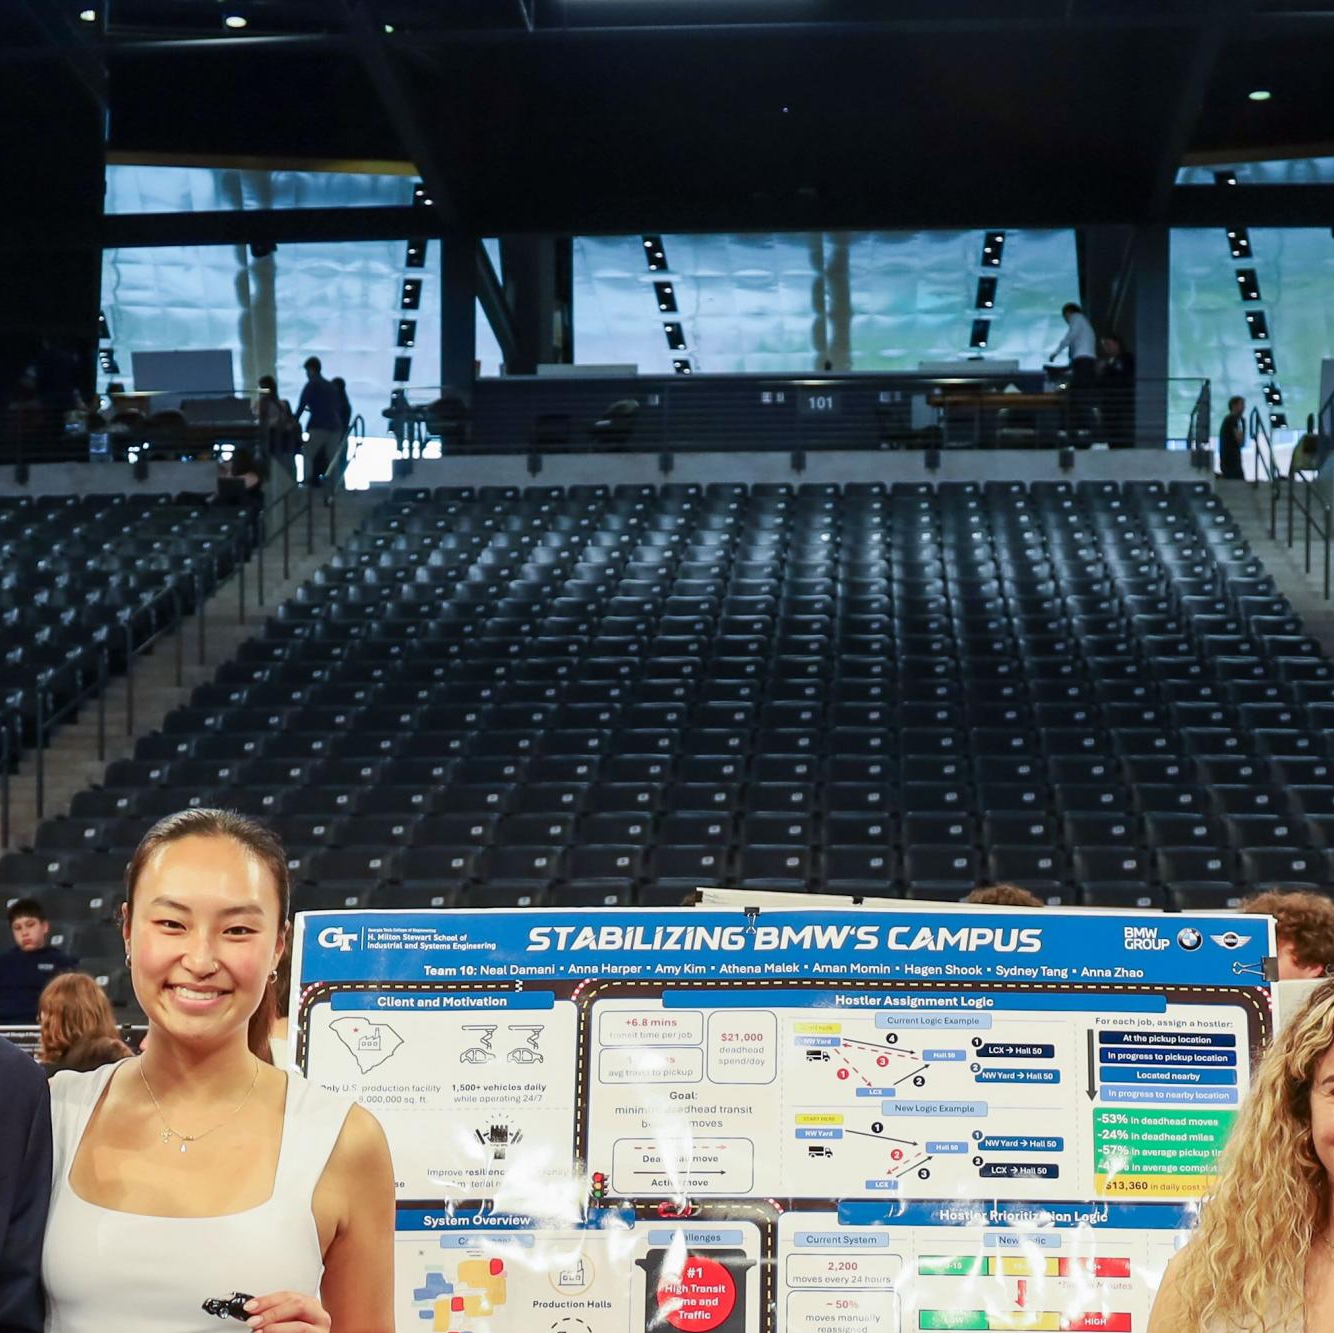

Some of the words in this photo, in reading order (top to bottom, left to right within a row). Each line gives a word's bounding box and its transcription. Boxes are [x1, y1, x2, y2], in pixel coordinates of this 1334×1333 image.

[809, 396, 833, 409] 101
[1124, 927, 1157, 938] BMW
[318, 927, 357, 951] GT
[526, 926, 745, 950] STABILIZING
[887, 926, 1042, 952] CAMPUS
[1125, 939, 1170, 950] GROUP
[424, 966, 456, 975] Team
[460, 966, 477, 975] 10:
[480, 965, 507, 975] Neal
[510, 965, 554, 975] Damani
[568, 964, 598, 973] Anna
[602, 965, 641, 974] Harper
[655, 965, 680, 975] Amy
[684, 965, 706, 973] Kim
[720, 964, 761, 973] Athena
[764, 963, 799, 973] Malek
[813, 963, 847, 973] Aman
[851, 963, 890, 974] Momin
[905, 965, 942, 977] Hagen
[945, 965, 982, 976] Shook
[996, 966, 1038, 978] Sydney
[1041, 966, 1068, 978] Tang
[1081, 967, 1111, 978] Anna
[1114, 968, 1143, 978] Zhao
[377, 997, 414, 1006] Client
[417, 997, 439, 1006] and
[443, 997, 507, 1006] Motivation
[835, 995, 881, 1006] Hostler
[884, 996, 957, 1007] Assignment
[960, 996, 993, 1007] Logic
[920, 1017, 941, 1025] Logic
[944, 1017, 979, 1026] Example
[722, 1034, 763, 1042] $21,000
[1097, 1114, 1128, 1123] -53%
[1141, 1117, 1186, 1125] deadhead
[424, 1216, 469, 1227] System
[473, 1215, 530, 1226] Overview
[828, 1262, 857, 1271] 2,200
[687, 1268, 703, 1278] #1
[665, 1285, 688, 1294] High
[691, 1284, 725, 1293] Transit
[533, 1300, 584, 1309] Production
[588, 1300, 611, 1309] Halls
[678, 1311, 710, 1320] Traffic
